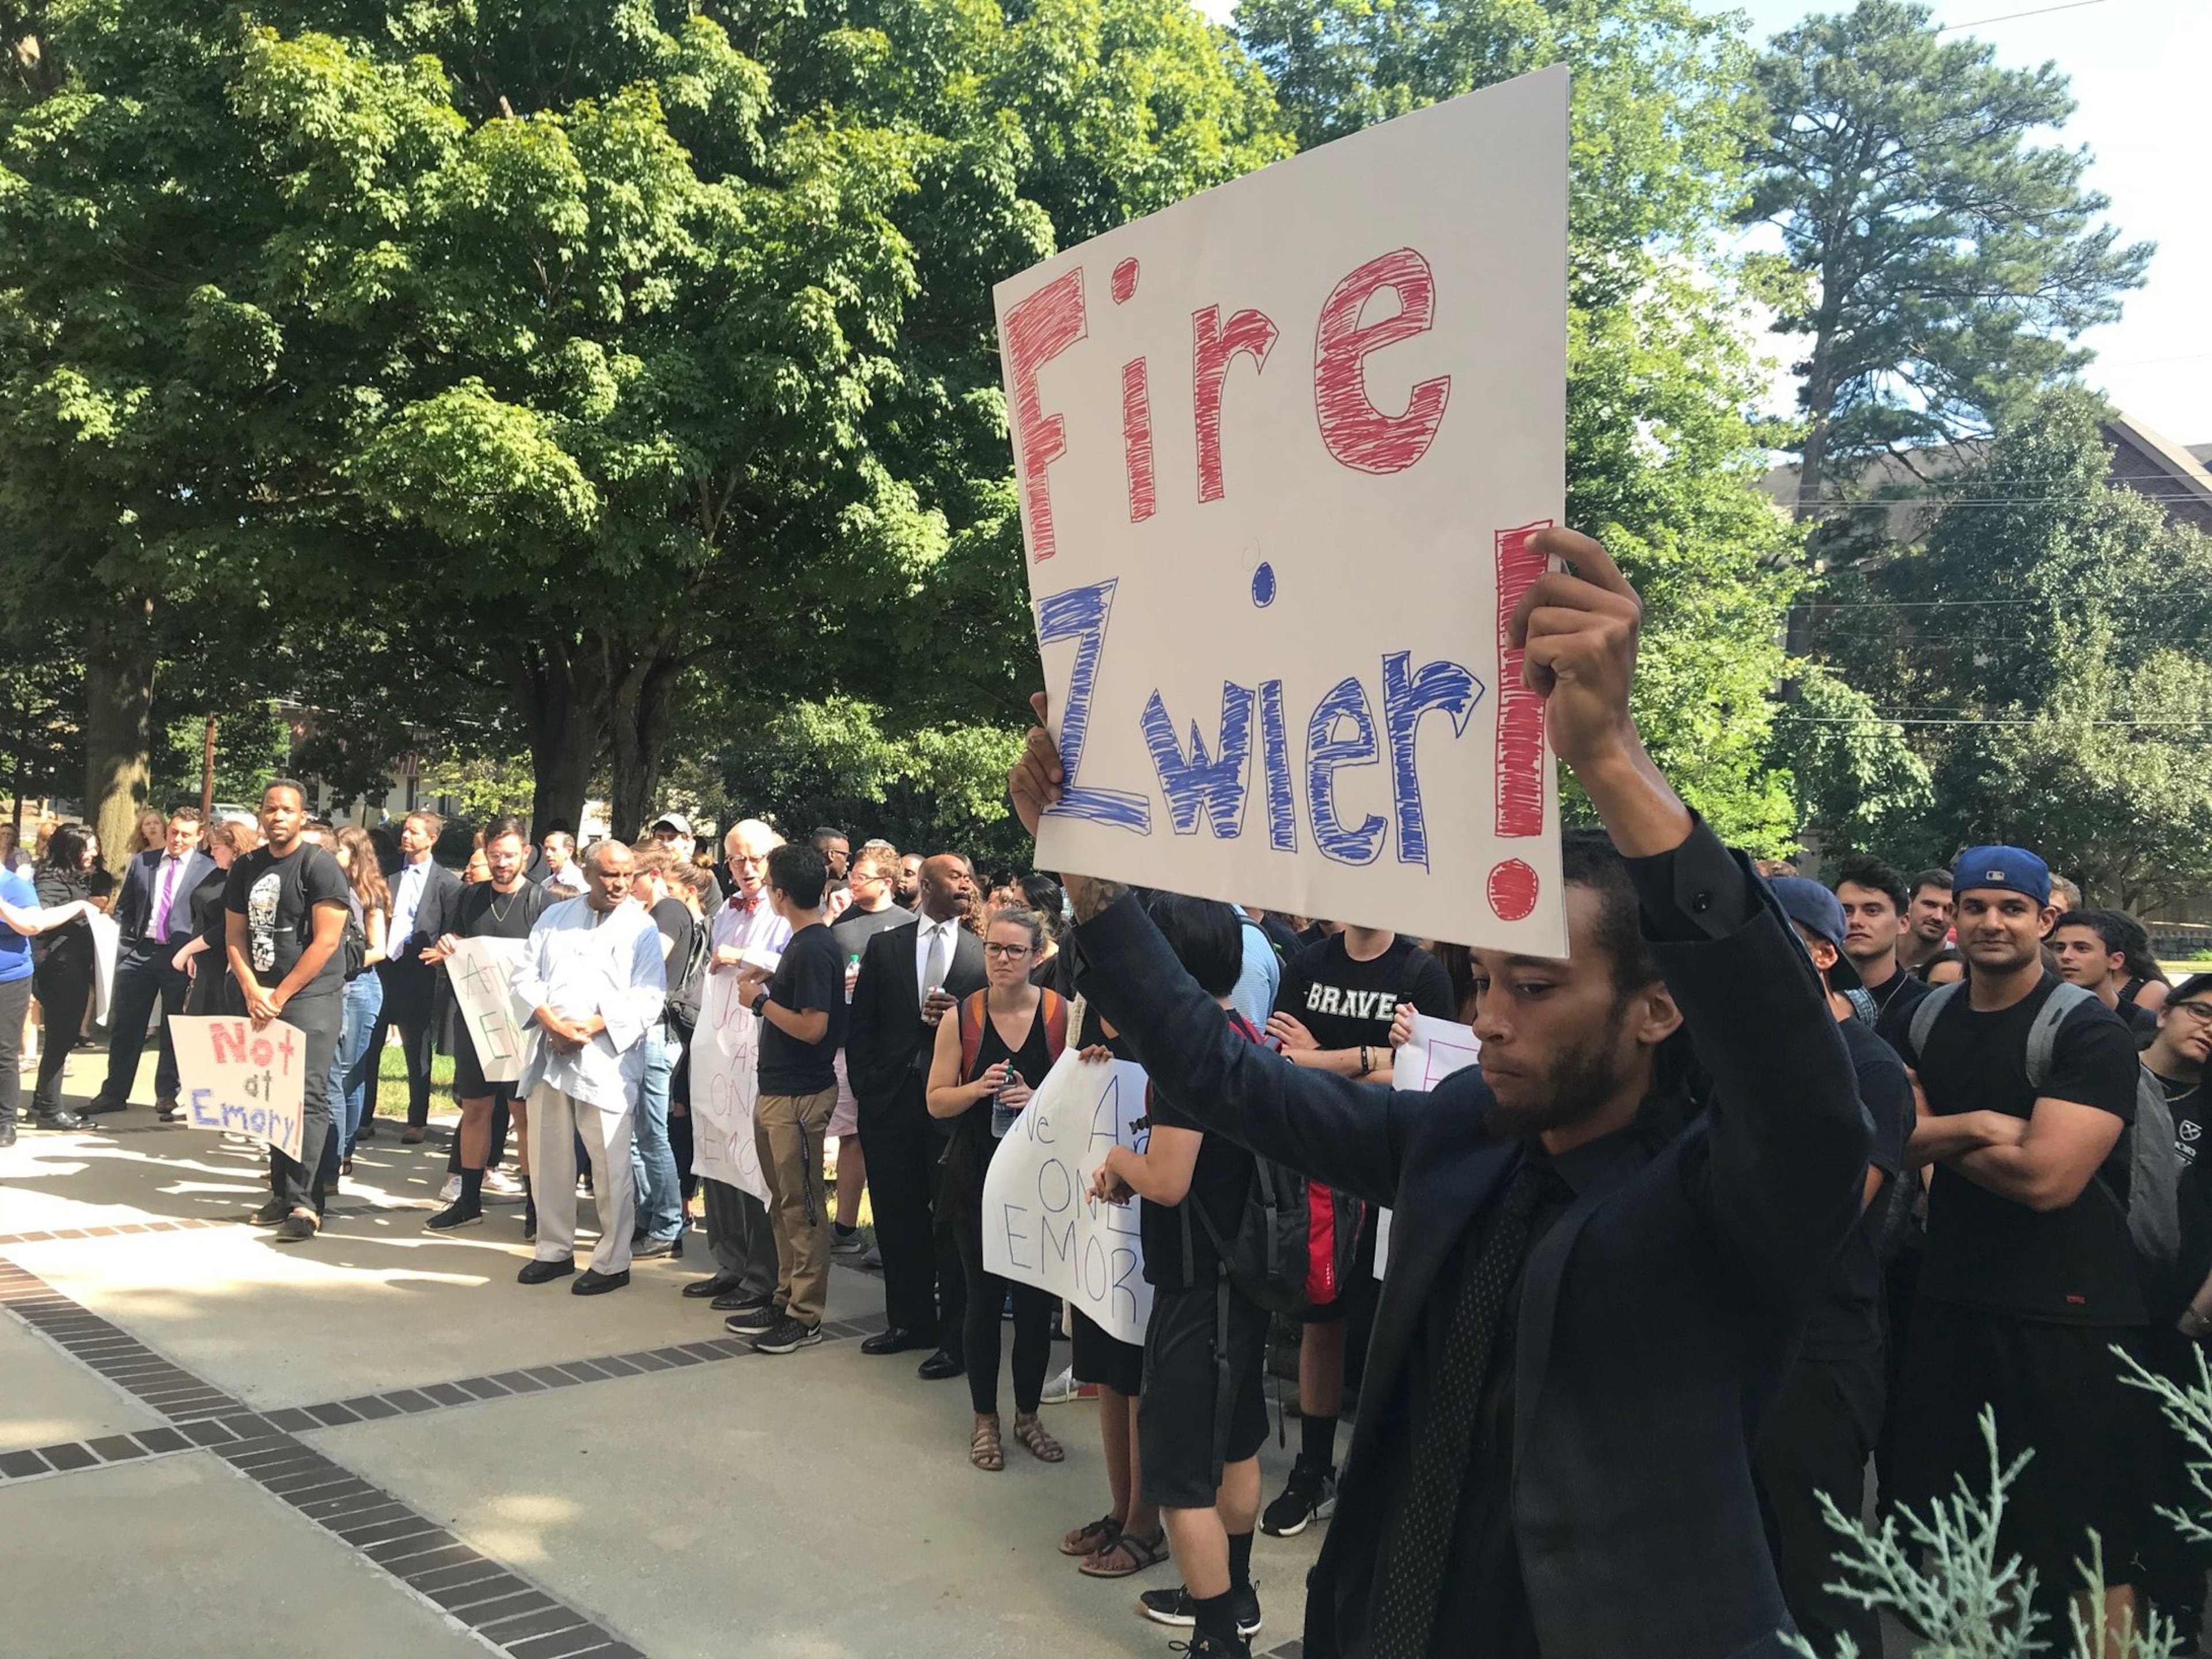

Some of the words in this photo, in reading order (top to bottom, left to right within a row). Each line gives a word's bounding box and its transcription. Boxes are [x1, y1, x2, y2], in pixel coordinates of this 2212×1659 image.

[1004, 247, 1450, 563] Fire
[1037, 520, 1554, 921] Zwier!
[1306, 982, 1397, 1021] BRAVE
[209, 1022, 294, 1076] Not
[244, 1070, 272, 1101] at
[191, 1088, 302, 1157] Emory!
[1004, 1203, 1137, 1324] EMOR
